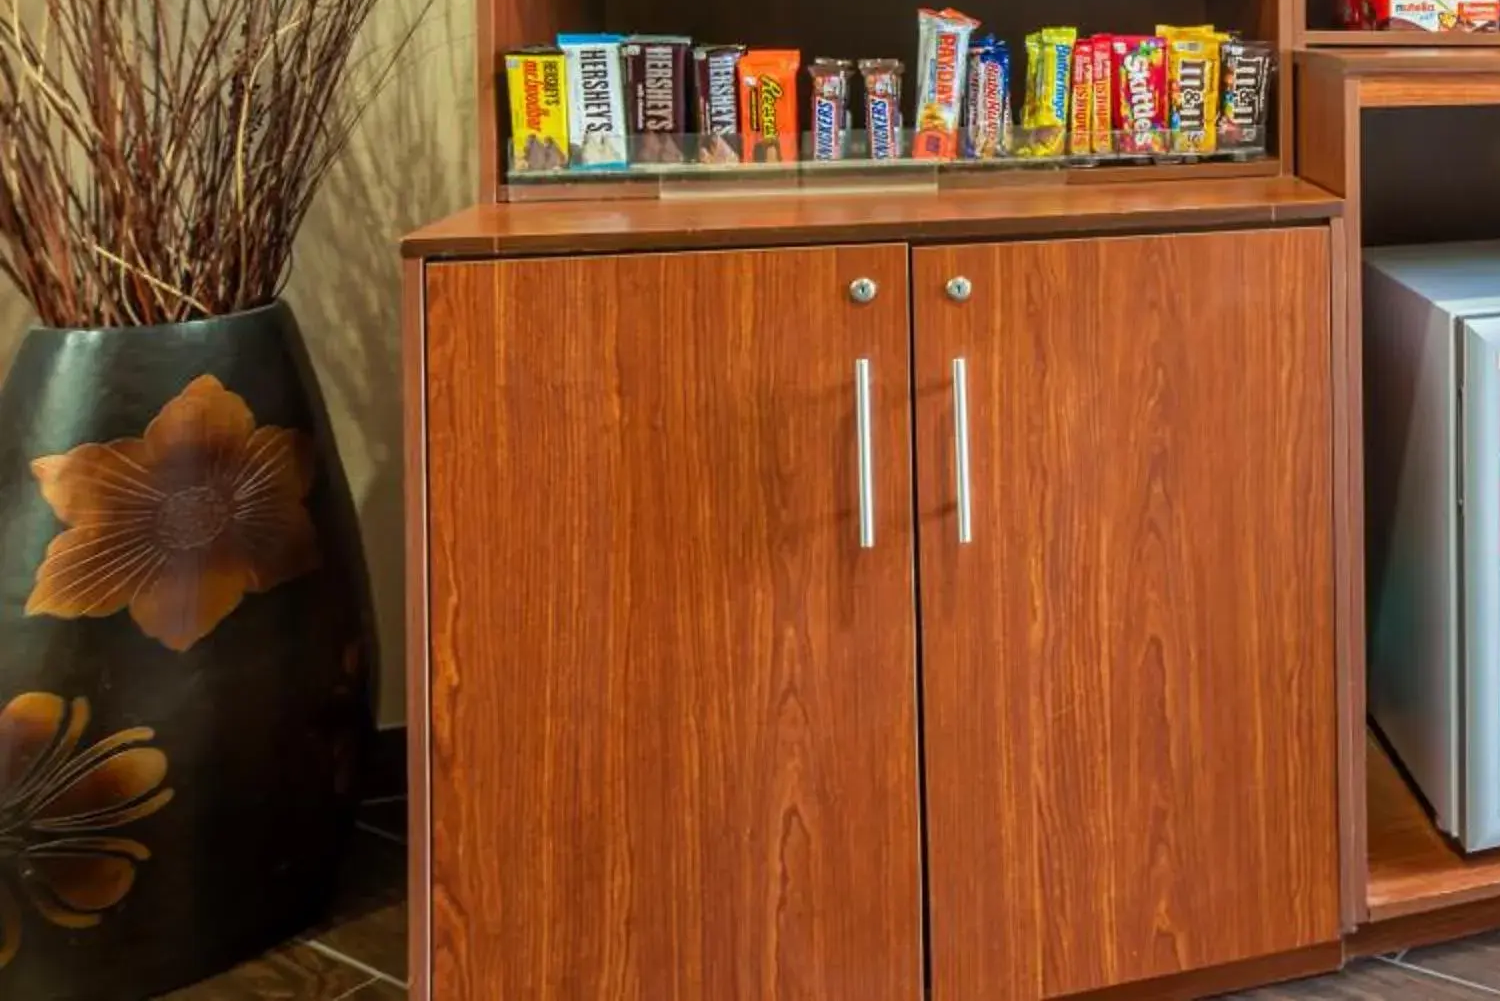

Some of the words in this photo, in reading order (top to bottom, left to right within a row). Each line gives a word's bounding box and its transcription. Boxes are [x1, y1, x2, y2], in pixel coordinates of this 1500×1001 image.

[543, 60, 561, 107] HERSHEY'S
[580, 49, 613, 135] HERSHEY'S
[645, 46, 674, 131] HERSHEY'S
[708, 54, 737, 135] HERSHEY'S
[760, 74, 784, 142] Reese's
[935, 33, 958, 104] PAYDAY
[1124, 54, 1155, 146] Skittles
